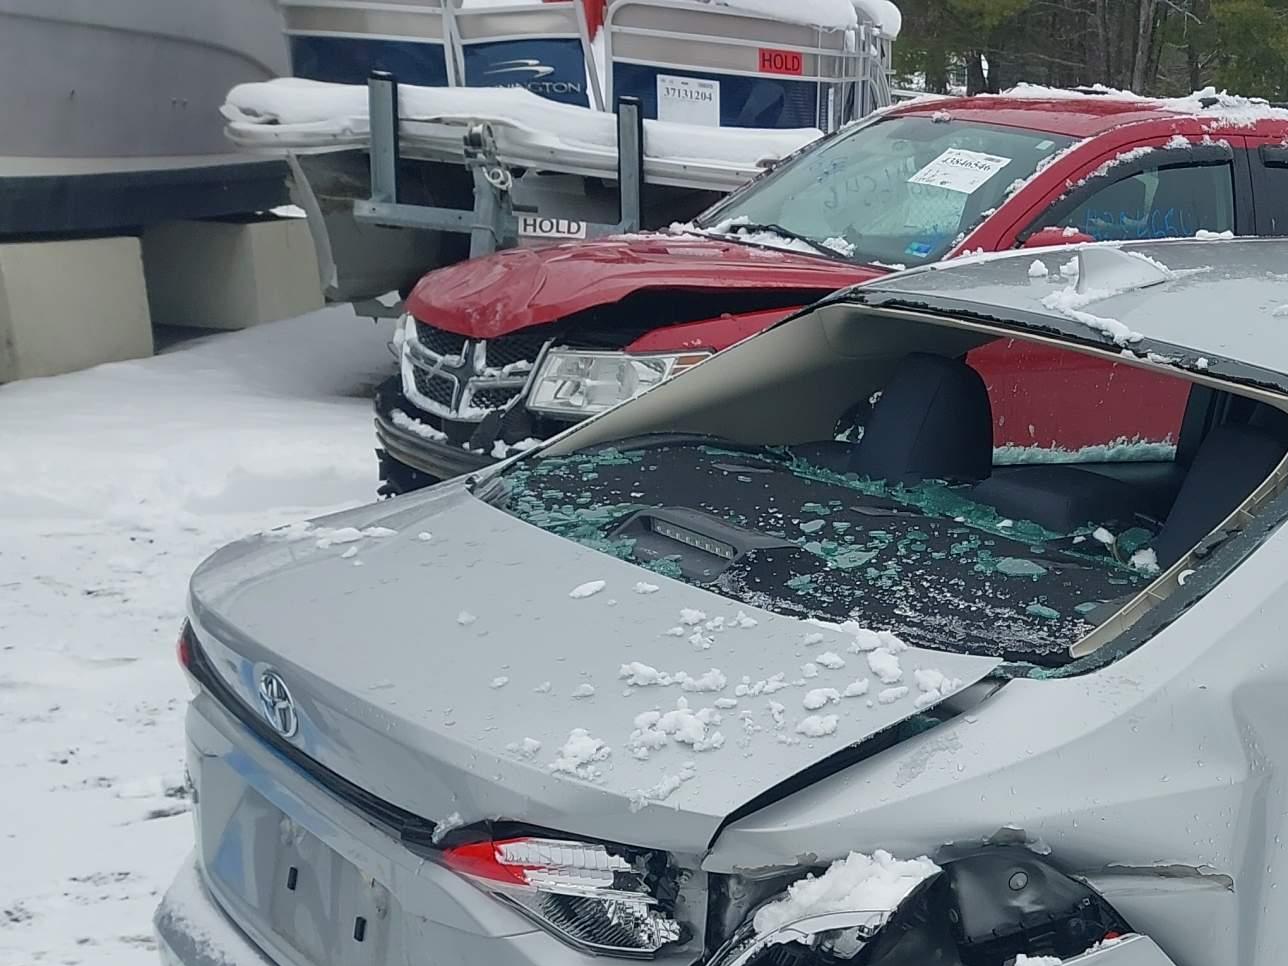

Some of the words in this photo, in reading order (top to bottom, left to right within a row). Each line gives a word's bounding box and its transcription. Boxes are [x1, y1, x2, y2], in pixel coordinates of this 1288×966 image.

[762, 52, 800, 71] HOLD
[664, 87, 712, 102] 37131204
[523, 218, 581, 234] HOLD
